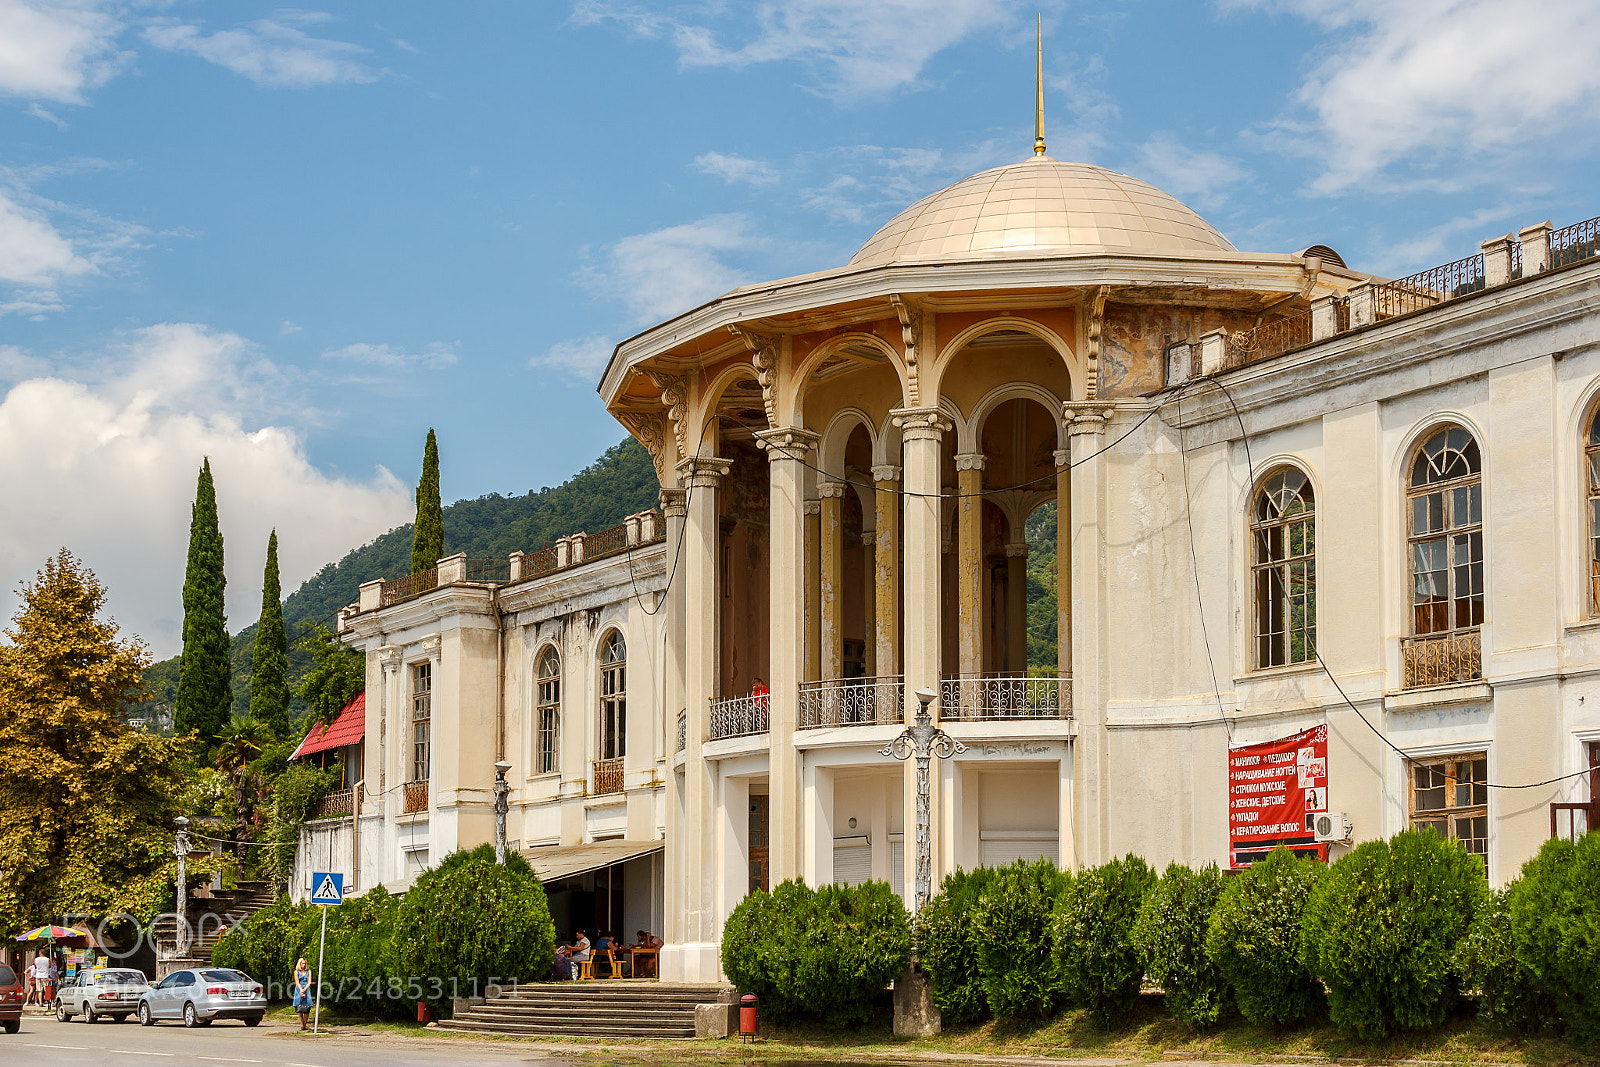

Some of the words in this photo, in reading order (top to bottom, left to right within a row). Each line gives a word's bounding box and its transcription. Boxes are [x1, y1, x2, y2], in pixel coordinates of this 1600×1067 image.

[1267, 752, 1296, 764] ПЕДИКЮР
[1235, 768, 1275, 780] НАРАЩИВАНИЕ
[1275, 764, 1296, 777] НОГТЕЙ
[1262, 795, 1286, 807] ДЕТСКИЕ
[1235, 812, 1259, 823] УКЛАДКИ
[1236, 824, 1280, 836] КЕРАТИРОВАНИЕ
[1280, 822, 1300, 832] ВОЛОС
